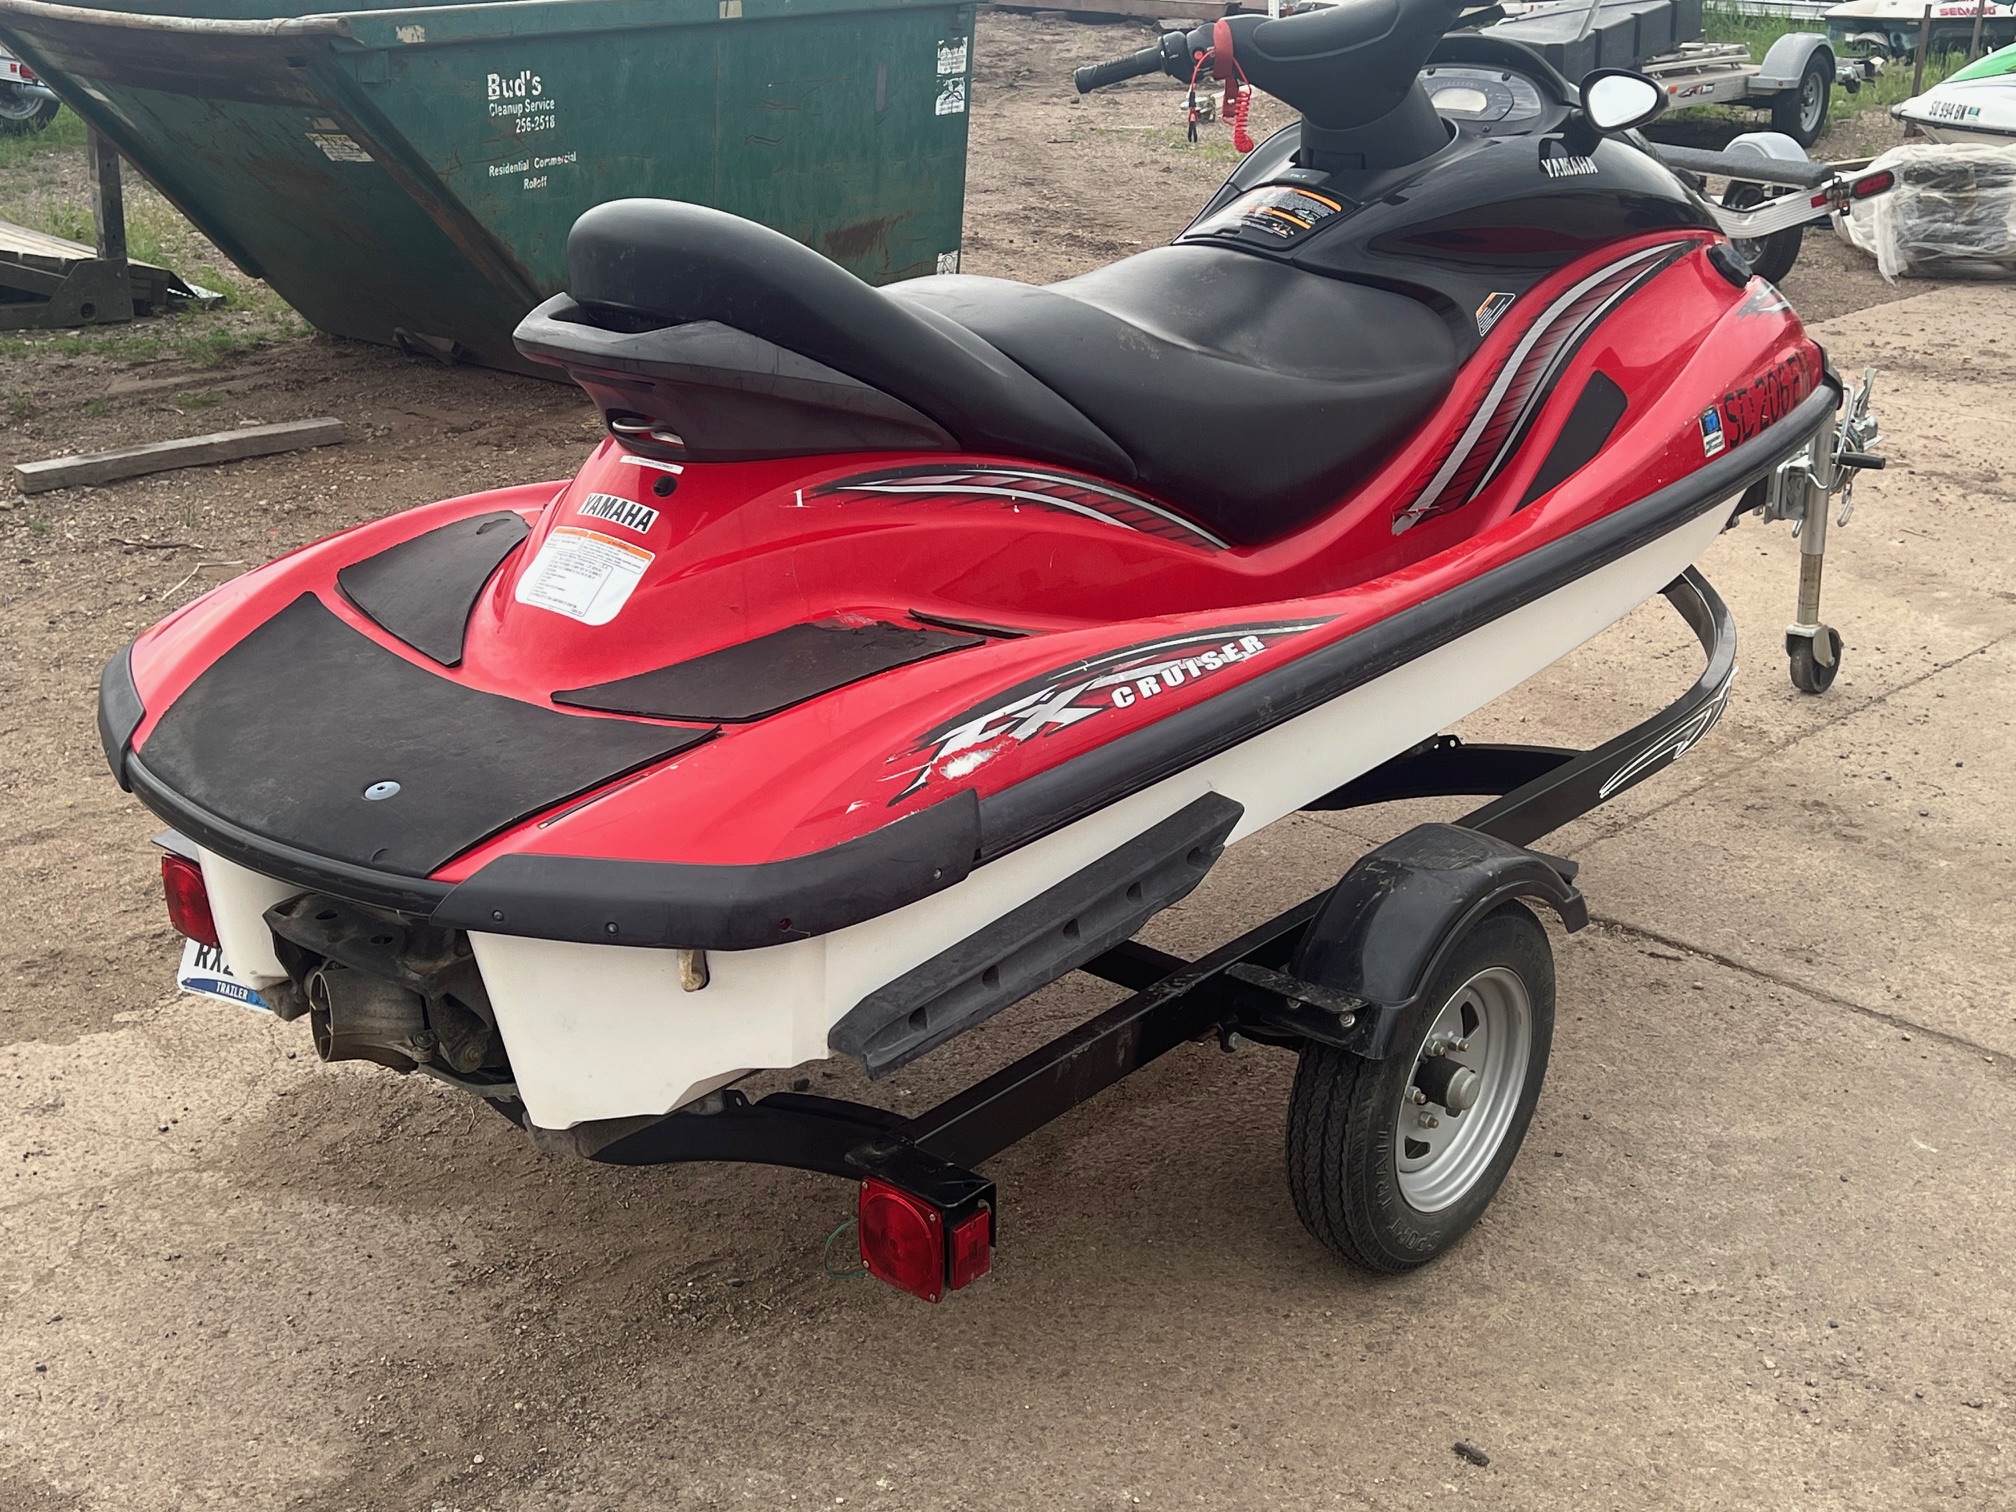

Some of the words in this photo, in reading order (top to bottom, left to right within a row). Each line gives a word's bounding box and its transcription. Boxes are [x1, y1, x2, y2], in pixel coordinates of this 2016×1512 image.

[487, 70, 542, 100] Bud's
[489, 102, 523, 117] Cleanup
[525, 97, 555, 112] Service
[515, 114, 556, 134] 256-2518
[488, 159, 530, 177] Residential
[534, 151, 577, 169] Commercial
[1540, 155, 1599, 178] YAMAHA
[580, 494, 655, 532] YAMAHA
[1111, 634, 1266, 709] CRUISER
[216, 981, 249, 1001] TRAILER
